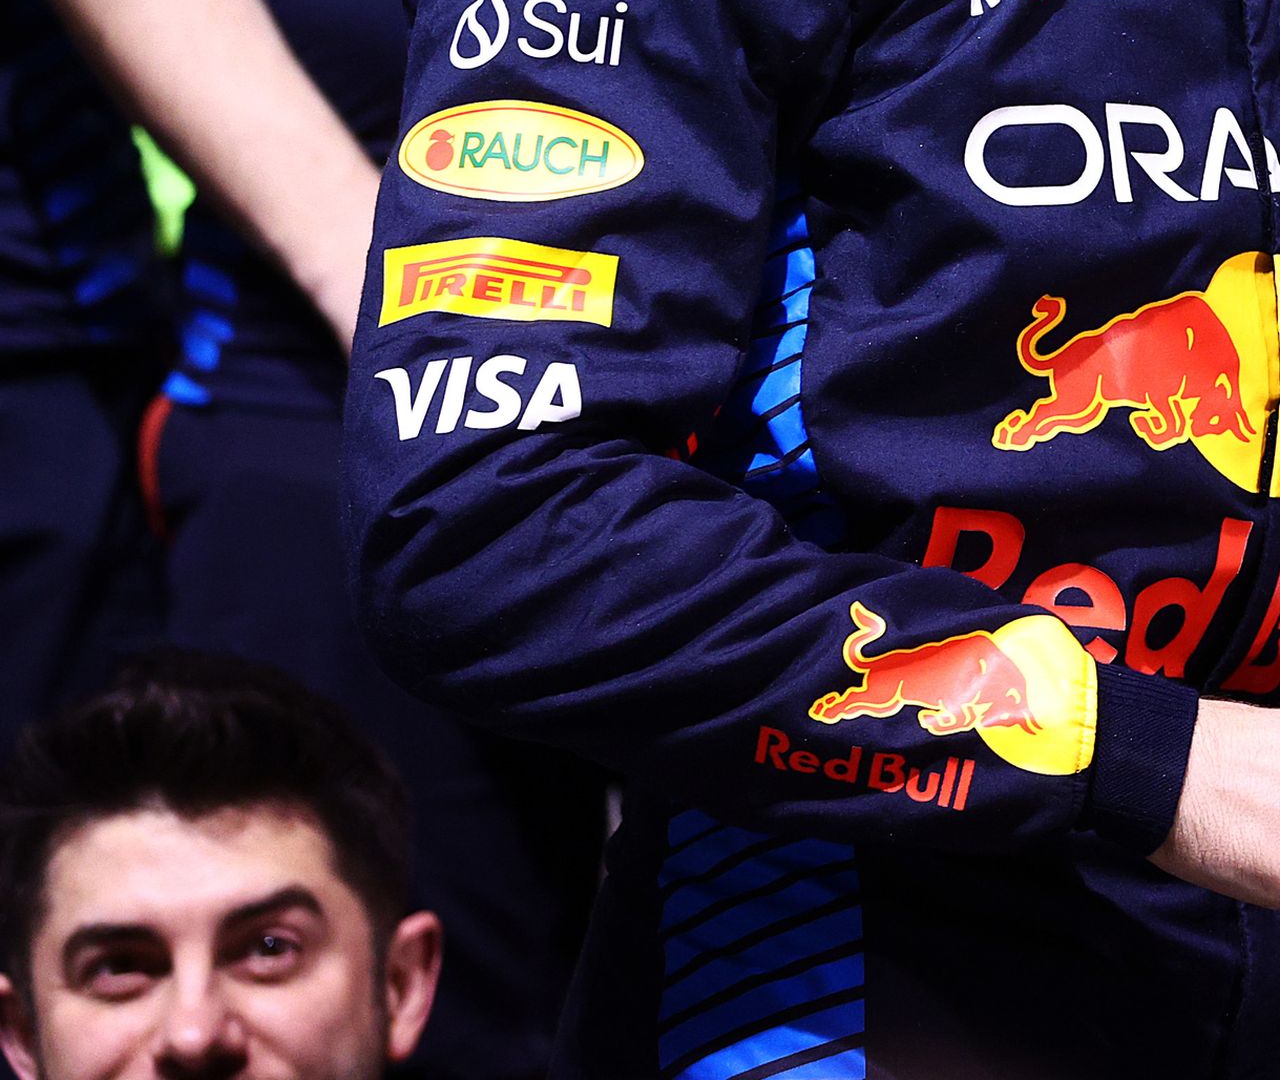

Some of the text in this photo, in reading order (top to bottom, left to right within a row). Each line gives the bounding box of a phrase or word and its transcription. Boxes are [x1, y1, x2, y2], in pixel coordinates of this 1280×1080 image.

[458, 131, 610, 179] RAUCH
[398, 252, 593, 313] PIRELLI
[374, 354, 582, 441] VISA
[754, 725, 976, 812] Red Bull
